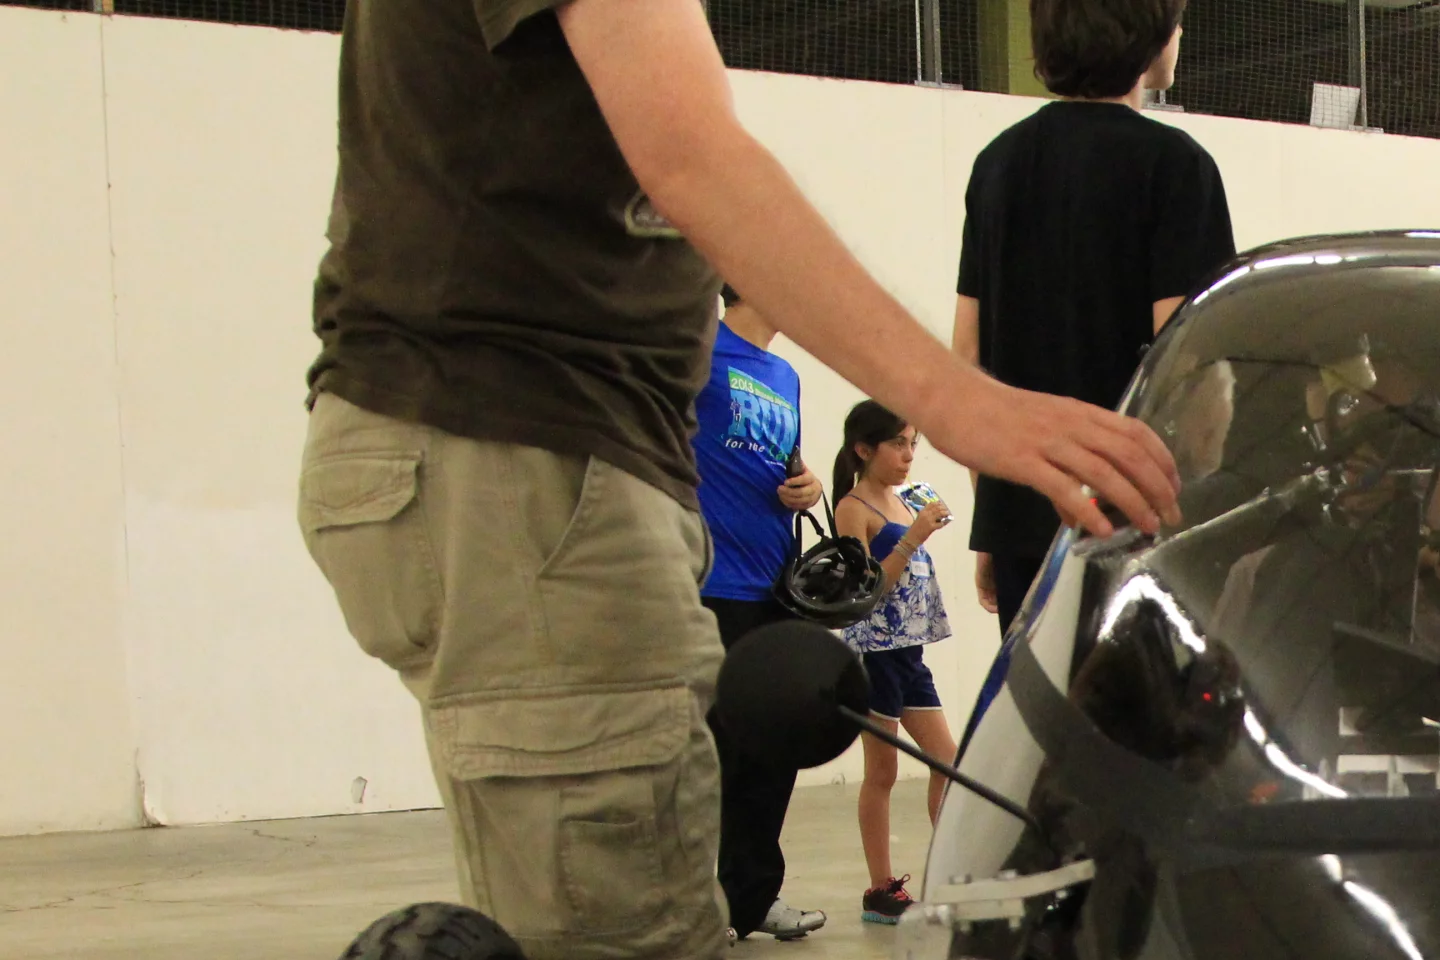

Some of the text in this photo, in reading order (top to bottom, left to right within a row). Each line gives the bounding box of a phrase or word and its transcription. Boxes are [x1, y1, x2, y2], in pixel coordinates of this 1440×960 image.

[731, 378, 754, 393] 2013
[728, 389, 799, 455] RUN
[725, 438, 765, 452] for the
